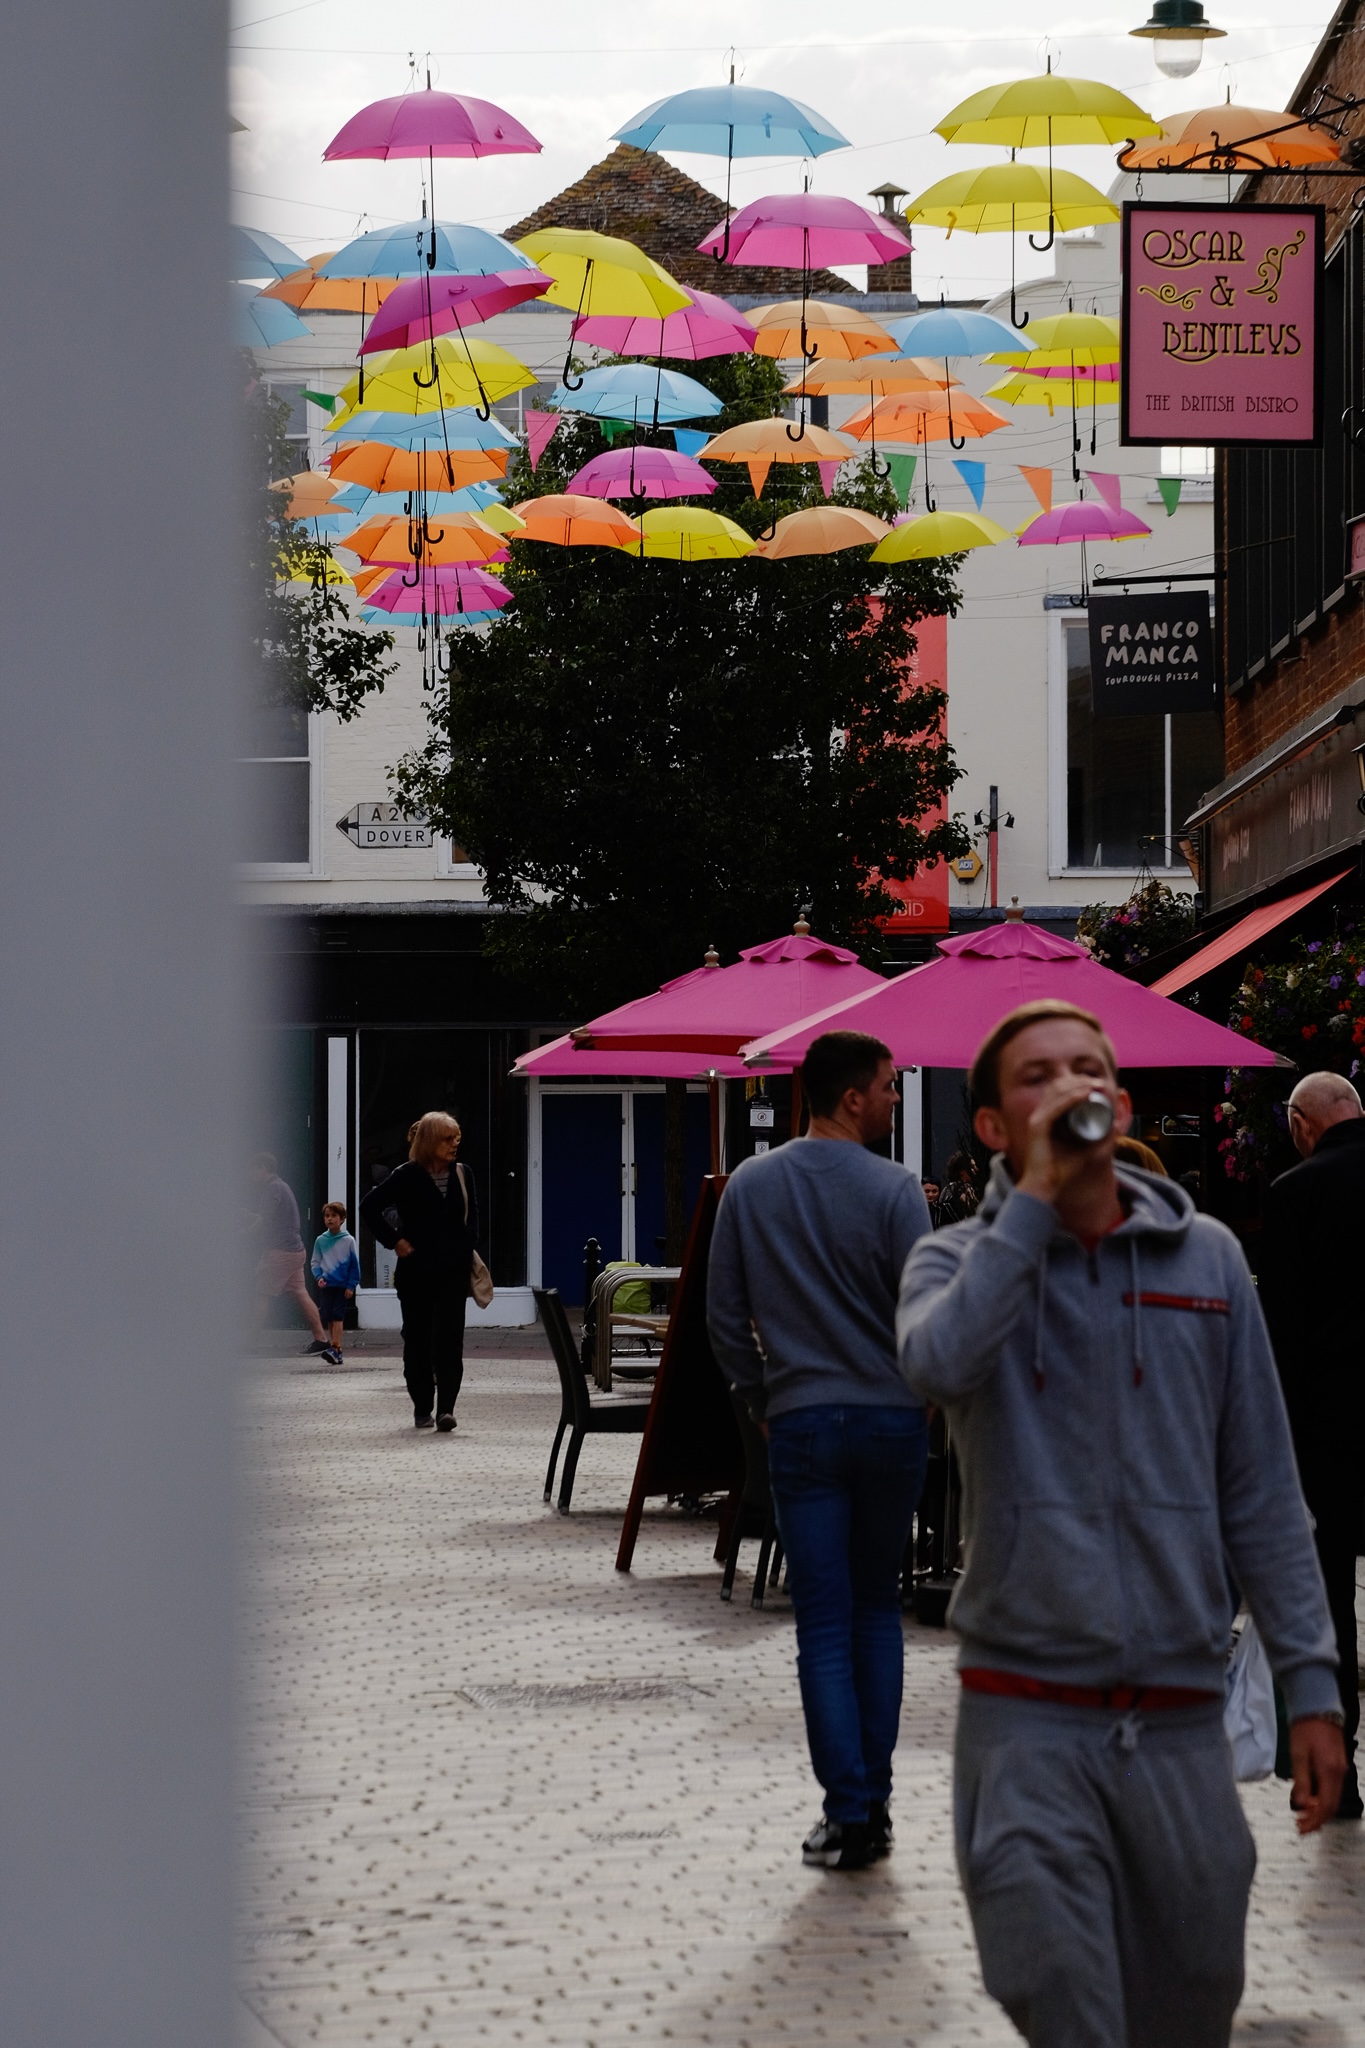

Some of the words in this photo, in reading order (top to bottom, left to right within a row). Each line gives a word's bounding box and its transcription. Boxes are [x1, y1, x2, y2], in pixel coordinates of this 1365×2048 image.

[1142, 229, 1245, 268] OSCAR
[1210, 276, 1235, 307] &
[1162, 321, 1301, 362] BENTLEYS
[1145, 394, 1171, 411] THE
[1181, 395, 1235, 412] BRITISH
[1245, 396, 1299, 414] BISTRO
[1100, 621, 1199, 644] FRANCO
[1105, 644, 1199, 668] MANCA
[1105, 673, 1161, 686] SOURDOUGH
[1165, 671, 1199, 682] PIZZA
[367, 830, 425, 842] DOVER
[958, 861, 974, 870] ADT
